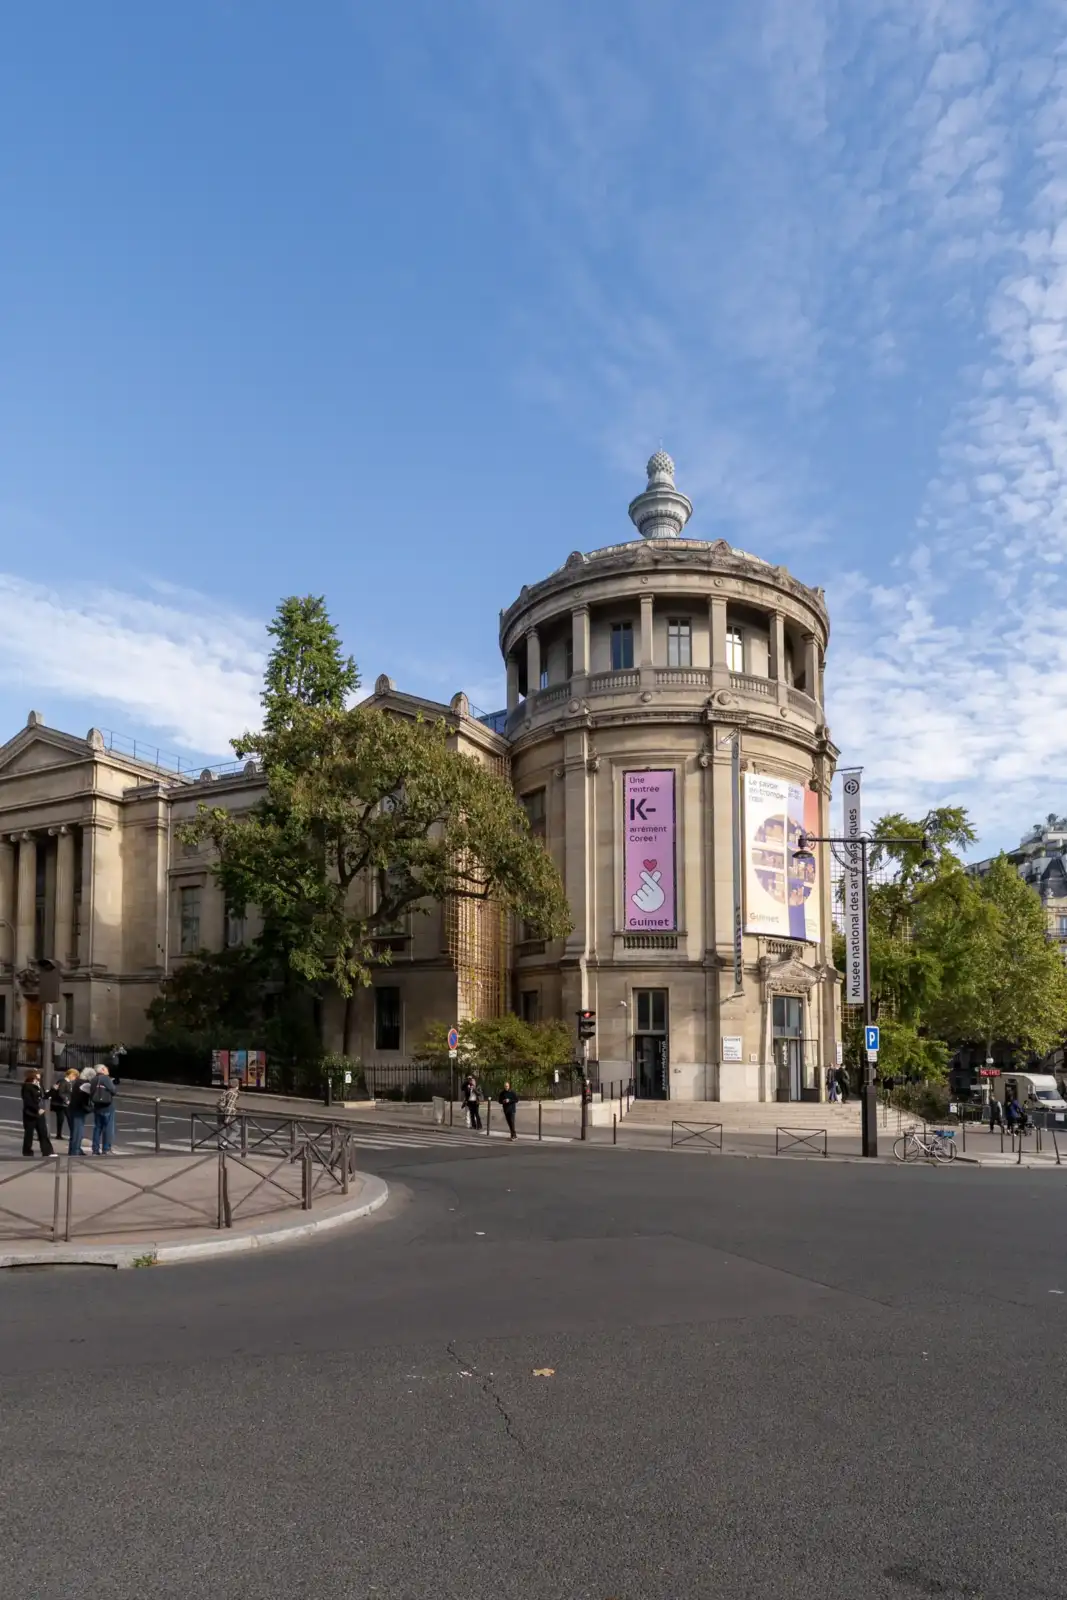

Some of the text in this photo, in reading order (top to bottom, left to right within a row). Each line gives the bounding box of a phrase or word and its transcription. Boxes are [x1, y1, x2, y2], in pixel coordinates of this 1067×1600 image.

[630, 798, 656, 820] K-
[850, 808, 860, 997] Musée national des arts asiaiques
[630, 918, 670, 926] Guimet
[868, 1032, 876, 1046] P
